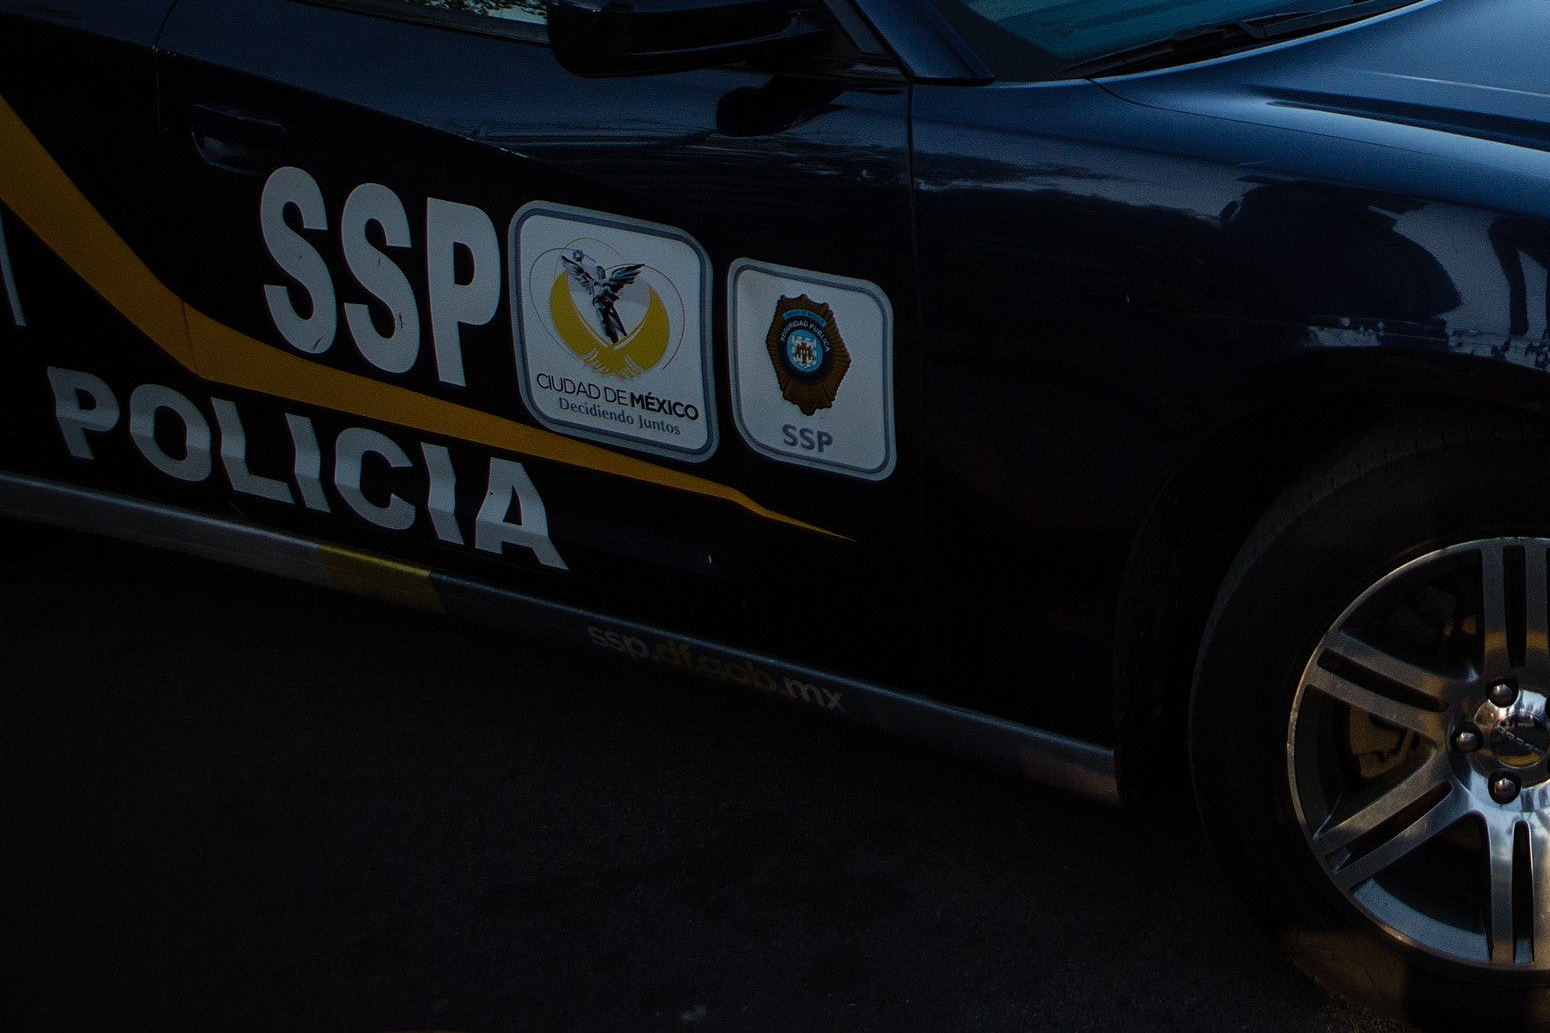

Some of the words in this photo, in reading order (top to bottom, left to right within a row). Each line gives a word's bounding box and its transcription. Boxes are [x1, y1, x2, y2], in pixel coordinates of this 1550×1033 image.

[259, 166, 502, 386] SSP
[780, 319, 809, 343] SEGURIDAD
[536, 373, 600, 400] CIUDAD
[604, 386, 629, 407] DE
[630, 391, 700, 421] MÉXICO
[559, 397, 634, 425] Decidiendo
[639, 414, 681, 435] Juntos
[781, 423, 834, 453] SSP
[46, 366, 570, 570] POLICIA
